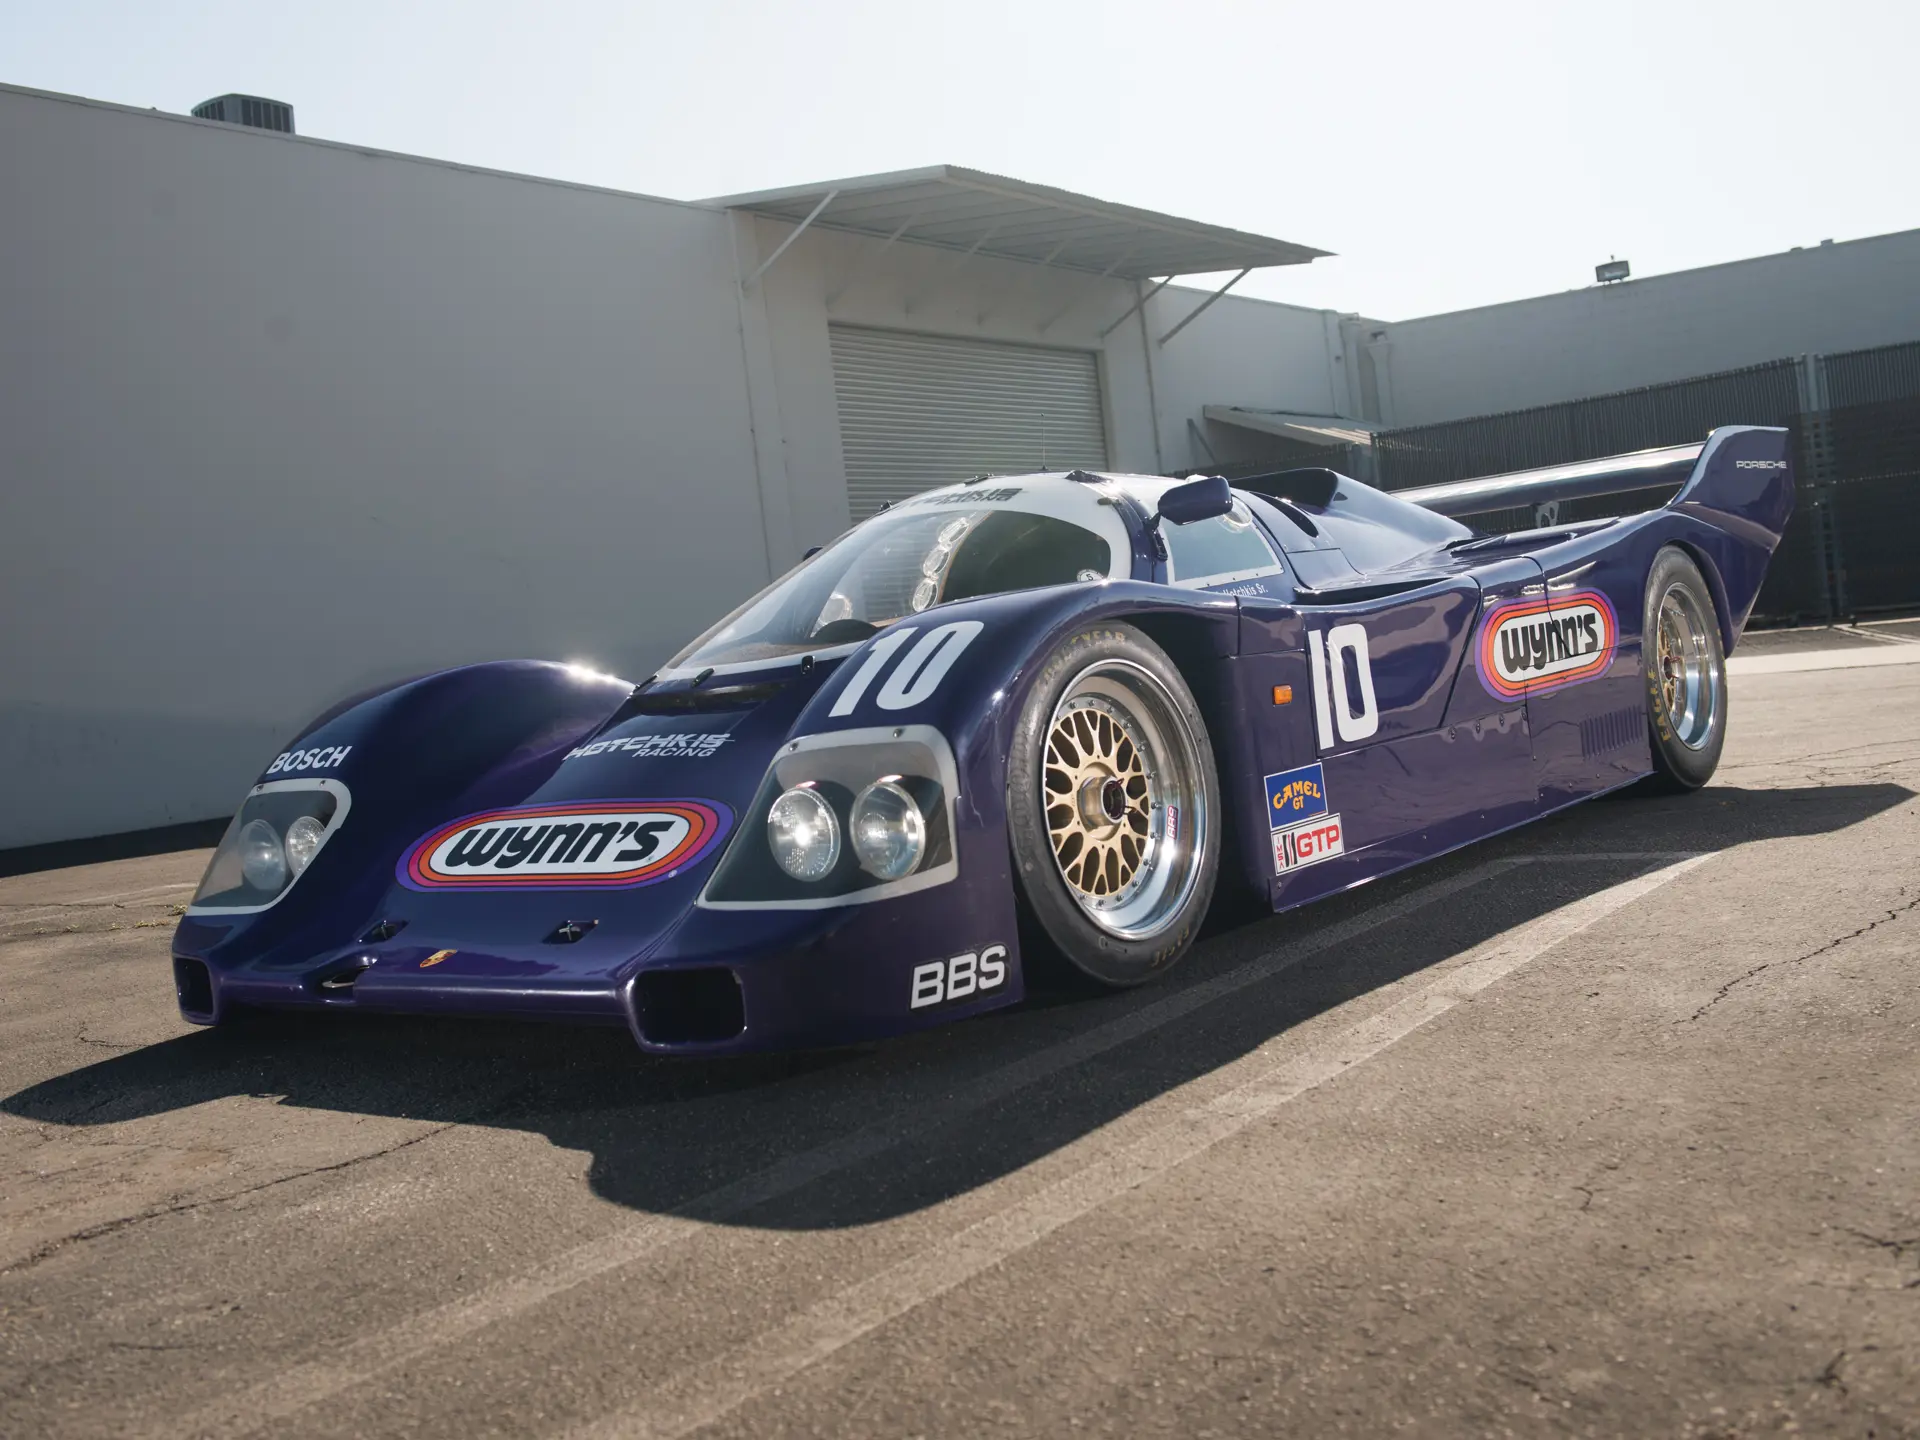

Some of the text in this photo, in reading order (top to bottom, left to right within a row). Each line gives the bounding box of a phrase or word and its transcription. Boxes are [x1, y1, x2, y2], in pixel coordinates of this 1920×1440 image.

[1735, 460, 1787, 469] PORSCHE
[828, 620, 985, 718] 10
[1307, 623, 1379, 751] 10
[265, 745, 353, 775] BOSCH
[561, 733, 733, 761] HOTCHKIS
[631, 747, 717, 758] RACING
[1272, 780, 1322, 810] CAMEL
[1292, 795, 1305, 811] GT
[1296, 824, 1341, 859] GTP
[910, 944, 1007, 1010] BBS
